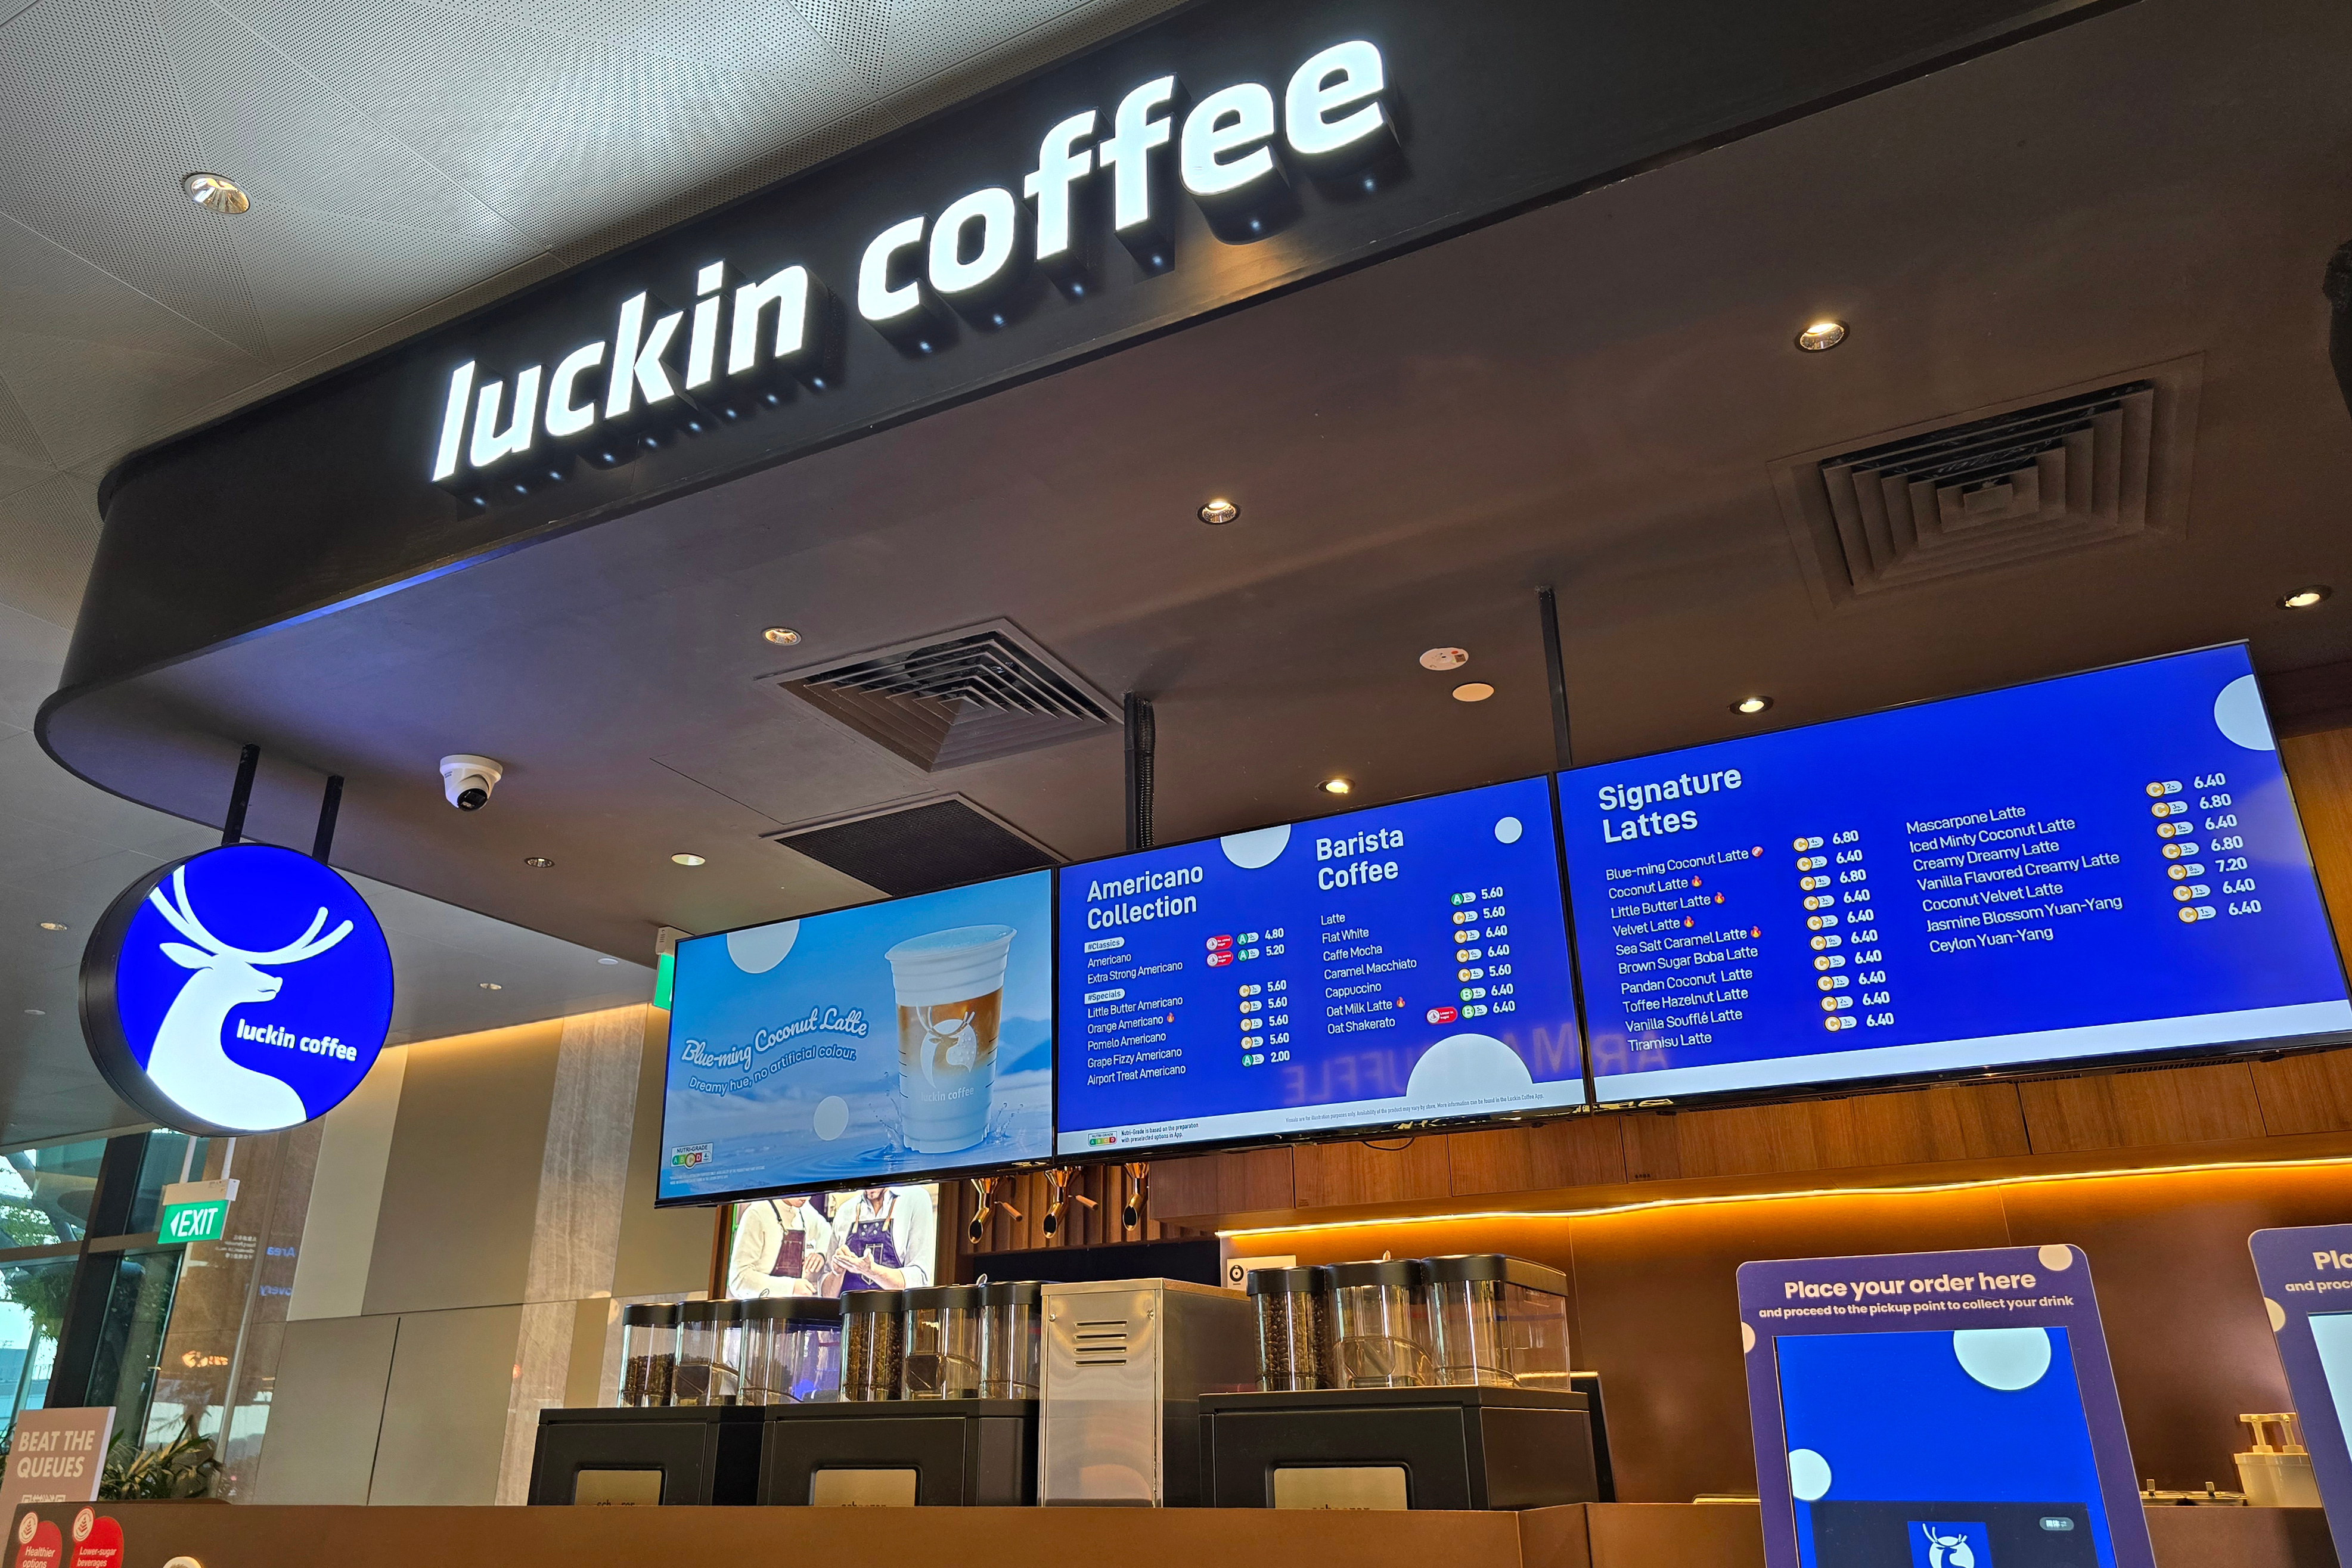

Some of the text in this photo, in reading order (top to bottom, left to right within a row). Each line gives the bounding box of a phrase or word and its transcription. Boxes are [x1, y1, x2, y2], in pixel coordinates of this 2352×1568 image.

[432, 40, 1384, 482] luckin coffee
[1598, 769, 1742, 811] Signature
[2199, 793, 2232, 809] 6.80
[1602, 810, 1698, 843] Lattes
[1906, 806, 2026, 834] Mascarpone Latte
[1315, 828, 1404, 861] Barista
[1909, 818, 2075, 853] Iced Minty Coconut Latte
[2211, 835, 2244, 852] 6.80
[1606, 849, 1749, 881] Blue-ming Coconut Latte
[1913, 840, 2060, 871] Creamy Dreamy Latte
[2215, 856, 2248, 873] 7.20
[1318, 860, 1398, 890] Coffee
[1916, 853, 2120, 891] Vanilla Flavored Creamy Latte
[1087, 866, 1203, 902] Americano
[1608, 878, 1689, 899] Coconut Latte
[1611, 895, 1711, 919] Little Butter Latte
[1922, 883, 2064, 912] Coconut Velvet Latte
[1087, 895, 1197, 930] Collection
[1320, 913, 1346, 926] Latte
[1926, 896, 2123, 932] Jasmine Blossom Yuan-Yang
[1264, 927, 1284, 940] 4.80
[1322, 927, 1369, 944] Flat White
[1612, 918, 1681, 937] Velvet Latte
[1088, 940, 1121, 951] #Classics
[1265, 943, 1285, 957] 5.20
[1615, 929, 1748, 956] Sea Salt Caramel Latte
[1929, 928, 2054, 953] Ceylon Yuan-Yang
[1087, 954, 1132, 968] Americano
[1323, 944, 1383, 961] Caffe Mocha
[1618, 946, 1758, 974] Brown Sugar Boba Latte
[1087, 962, 1183, 985] Extra Strong Americano
[1324, 958, 1417, 980] Caramel Macchiato
[1267, 979, 1287, 992] 5.60
[1325, 983, 1382, 999] Cappuccino
[1621, 968, 1753, 995] Pandan Coconut Latte
[1087, 990, 1121, 1002] #Specials
[1267, 996, 1288, 1009] 5.60
[1622, 988, 1749, 1013] Toffee Hazelnut Latte
[1088, 996, 1183, 1019] Little Butter Americano
[1326, 999, 1393, 1017] Oat Milk Latte
[1087, 1016, 1163, 1034] Orange Americano
[1268, 1014, 1289, 1027] 5.60
[1327, 1017, 1396, 1035] Oat Shakerato
[1624, 1009, 1743, 1033] Vanilla Soufflé Latte
[236, 1018, 357, 1061] luckin coffee
[681, 1008, 867, 1070] Blue-ming Coconut Latte
[1088, 1033, 1166, 1051] Pomelo Americano
[1270, 1032, 1290, 1045] 5.60
[1627, 1032, 1712, 1052] Tiramisu Latte
[1087, 1048, 1183, 1069] Grape Fizzy Americano
[1270, 1050, 1290, 1063] 2.00
[690, 1045, 856, 1095] Dreamy hue, no artificial colour.
[1087, 1065, 1186, 1086] Airport Treat Americano
[948, 1087, 974, 1100] coffee
[677, 1145, 708, 1153] NUTRI-GRADE
[177, 1207, 219, 1237] EXIT
[1784, 1272, 2037, 1302] Place your order here
[2285, 1281, 2314, 1291] and
[1758, 1295, 2074, 1320] and proceed to the pickup point to collect your drink
[18, 1430, 95, 1452] BEAT THE
[17, 1456, 85, 1479] QUEUES
[25, 1546, 55, 1557] Healthier
[79, 1547, 117, 1558] Lower-sugar
[23, 1558, 47, 1568] options
[77, 1558, 107, 1568] beverages
